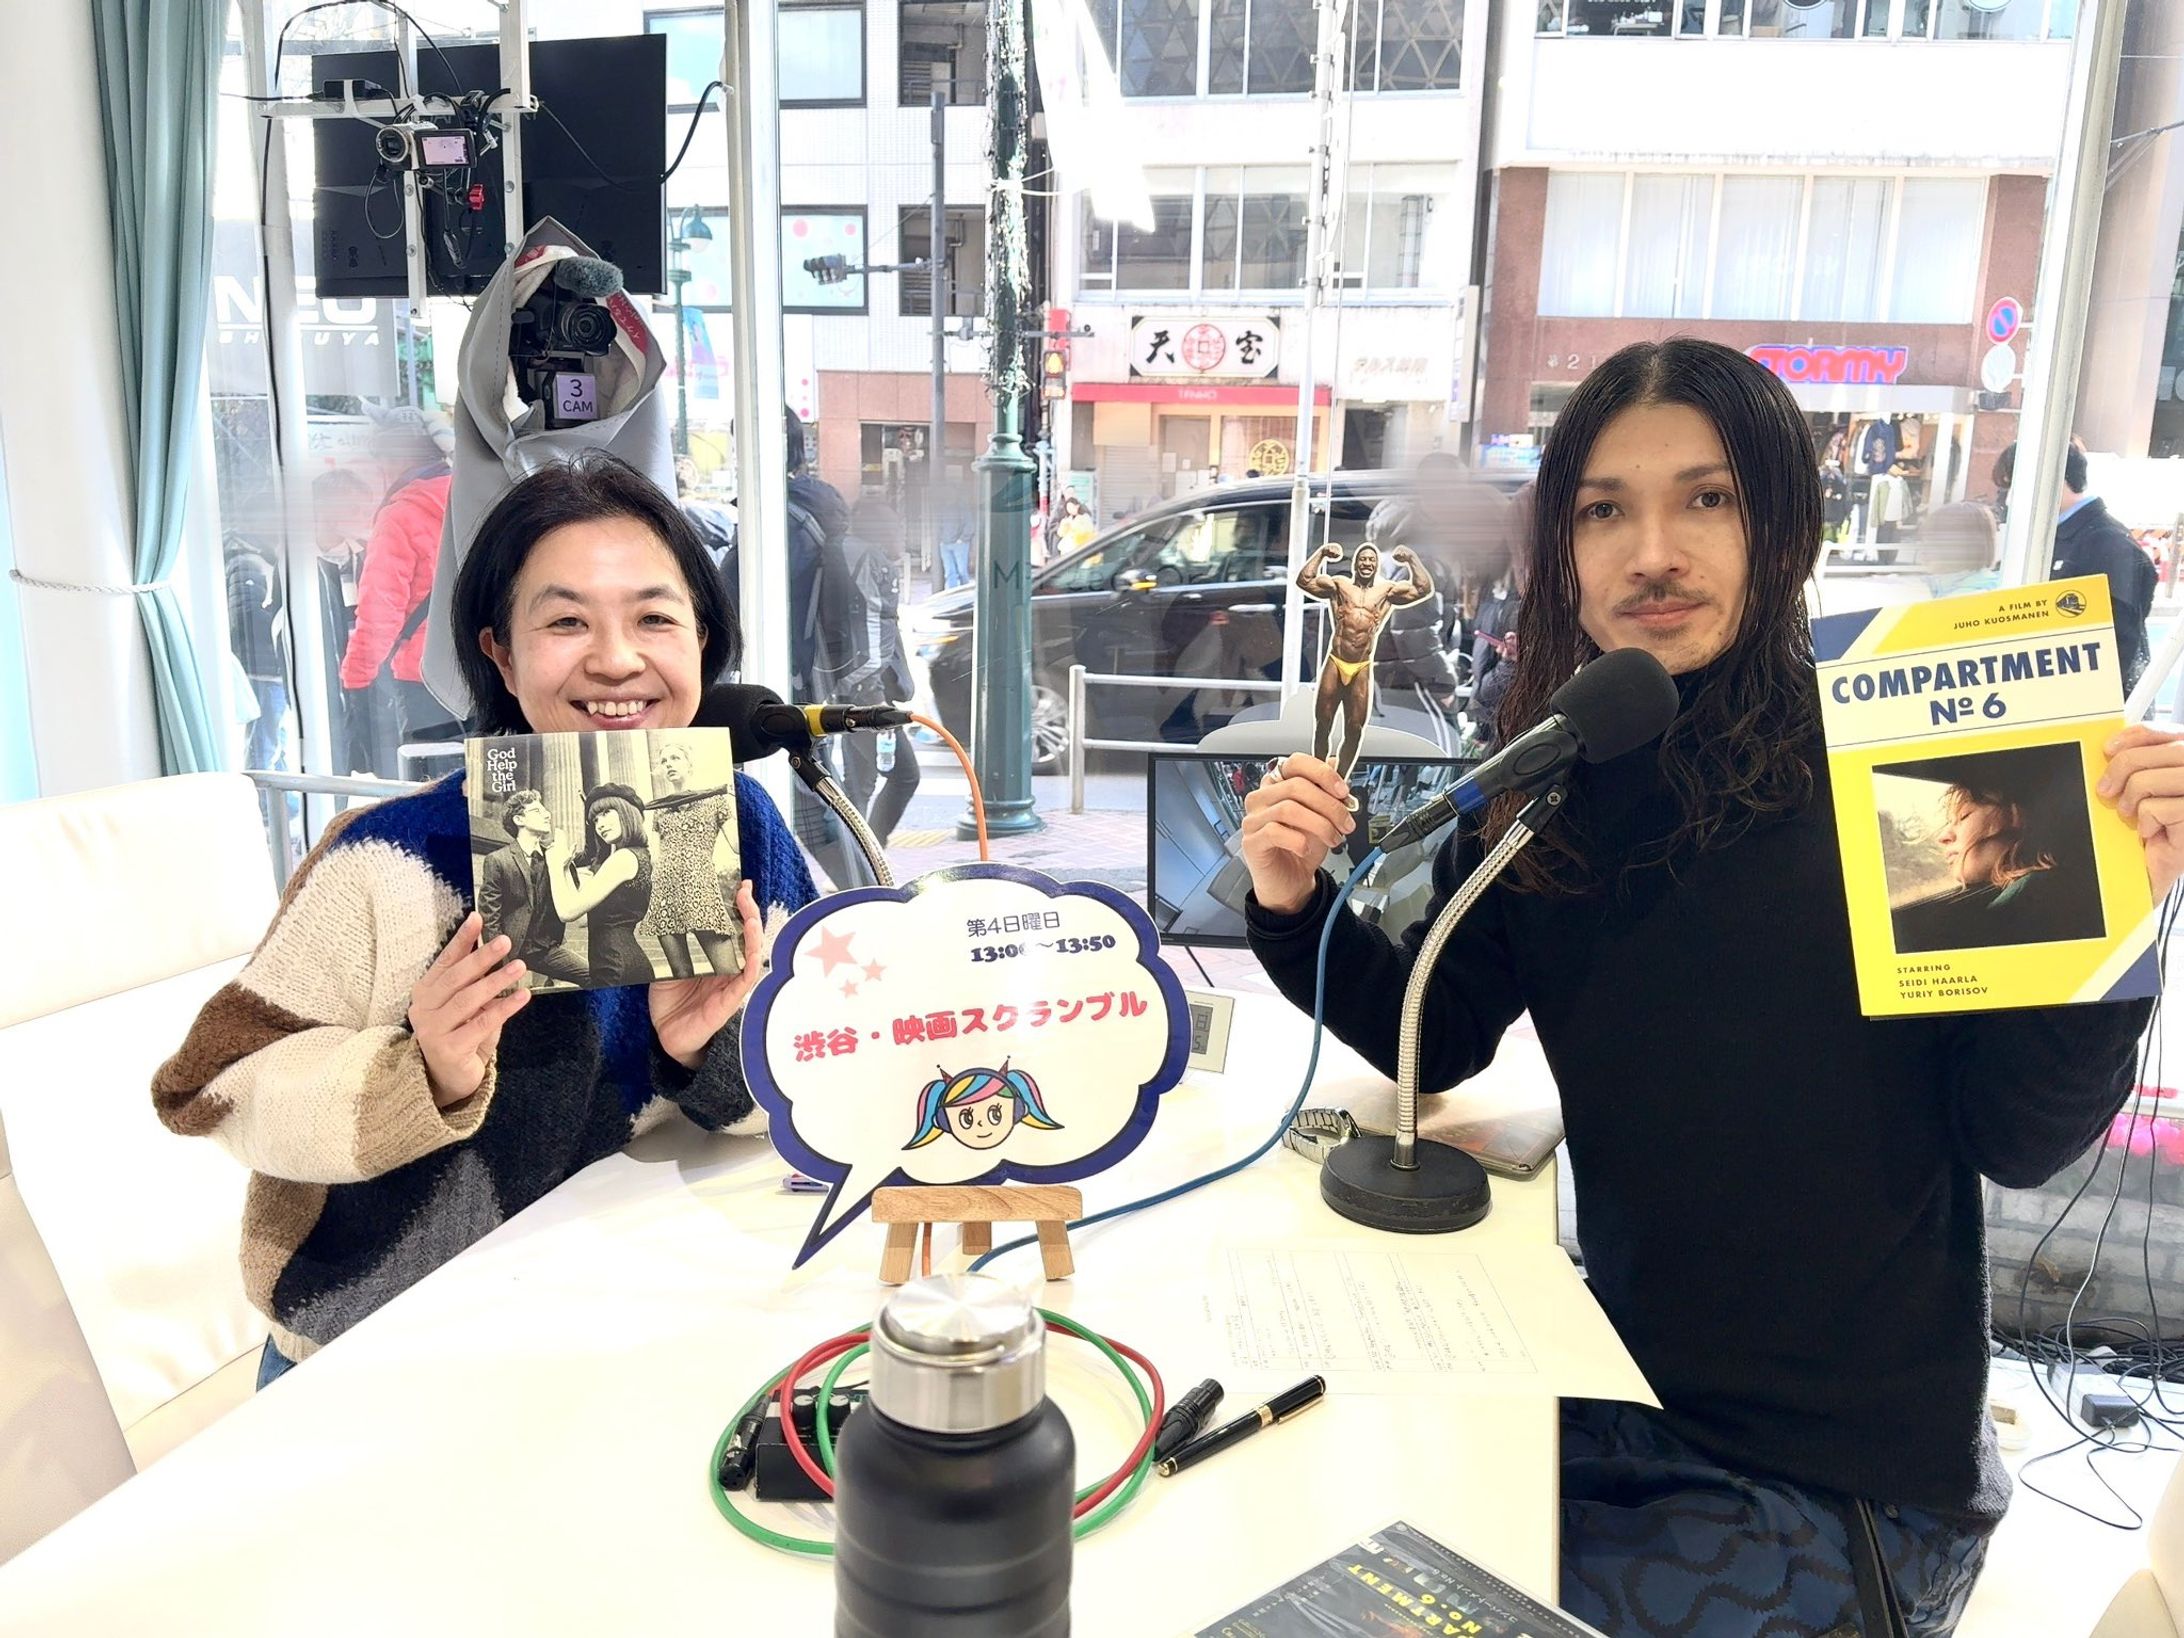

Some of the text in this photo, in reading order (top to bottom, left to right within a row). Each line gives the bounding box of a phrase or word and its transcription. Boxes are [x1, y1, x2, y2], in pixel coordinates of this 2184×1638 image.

[569, 379, 583, 398] 3
[562, 399, 594, 413] CAM
[2009, 602, 2032, 611] FILM
[2035, 599, 2048, 607] BY
[1953, 610, 2050, 630] JUHO KUOSMANEN
[1831, 642, 2101, 704] COMPARTMENT
[1982, 692, 2007, 719] 6
[487, 747, 516, 761] God
[486, 759, 518, 772] Help
[492, 770, 514, 782] the
[491, 780, 517, 793] Girl
[966, 911, 1060, 938] 第4日曜日
[1896, 963, 1951, 974] STARRING
[1899, 975, 1978, 988] SEIDI HAARLA
[1900, 986, 1989, 1000] YURIY BORISOV
